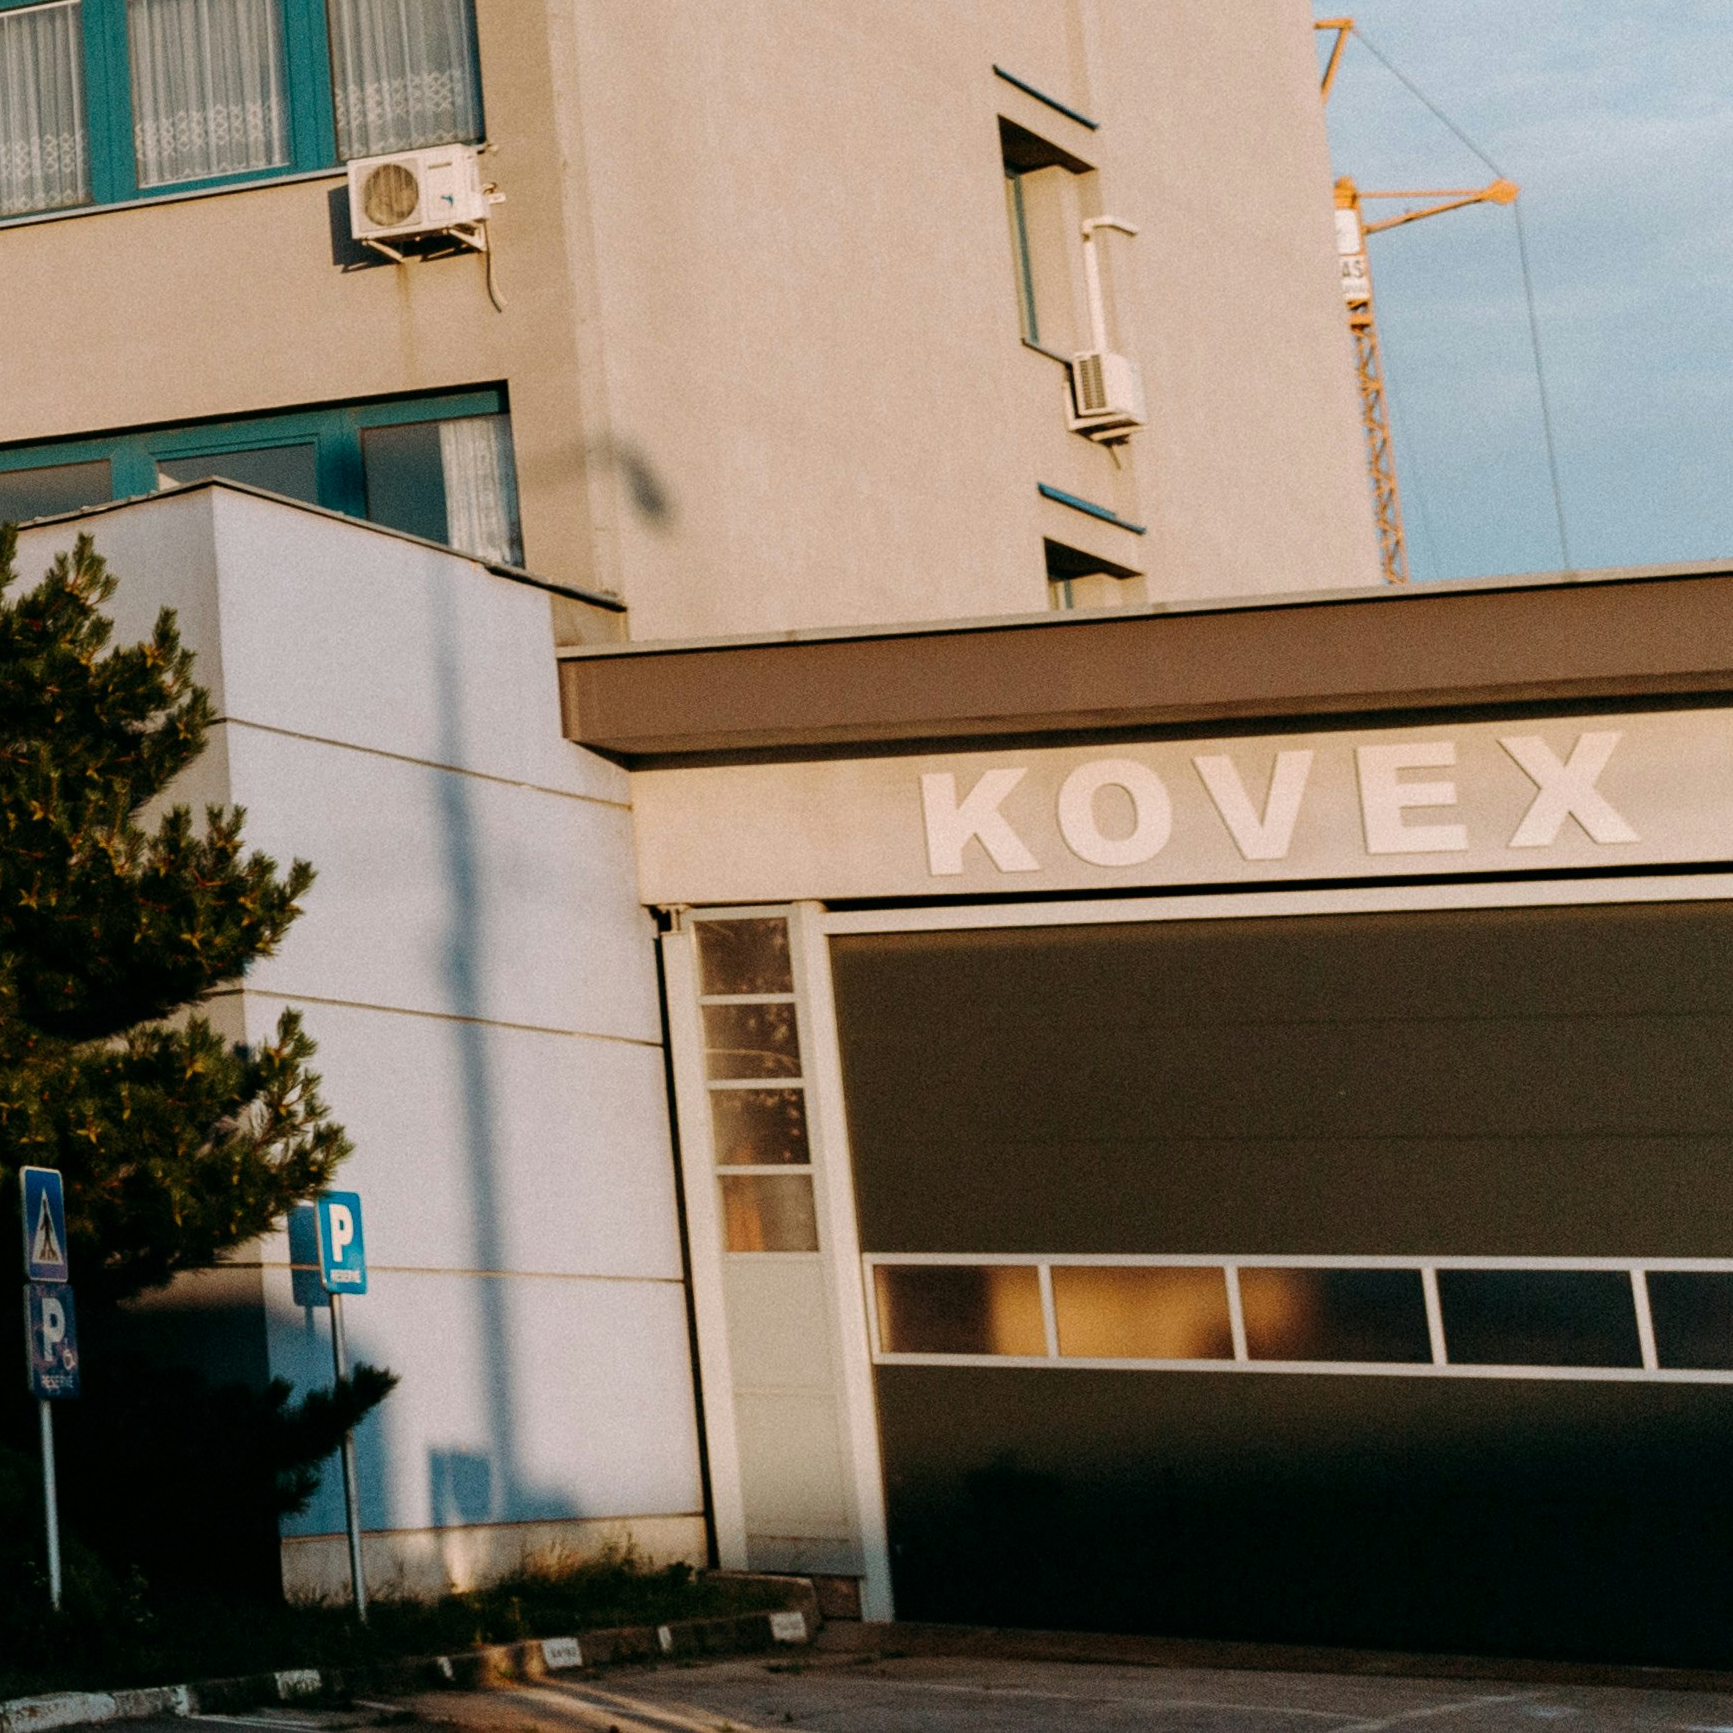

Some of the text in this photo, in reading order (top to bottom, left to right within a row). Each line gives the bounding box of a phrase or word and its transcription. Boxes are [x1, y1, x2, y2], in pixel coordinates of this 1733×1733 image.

[922, 730, 1643, 878] KOVEX
[329, 1203, 354, 1263] P
[42, 1297, 66, 1362] P
